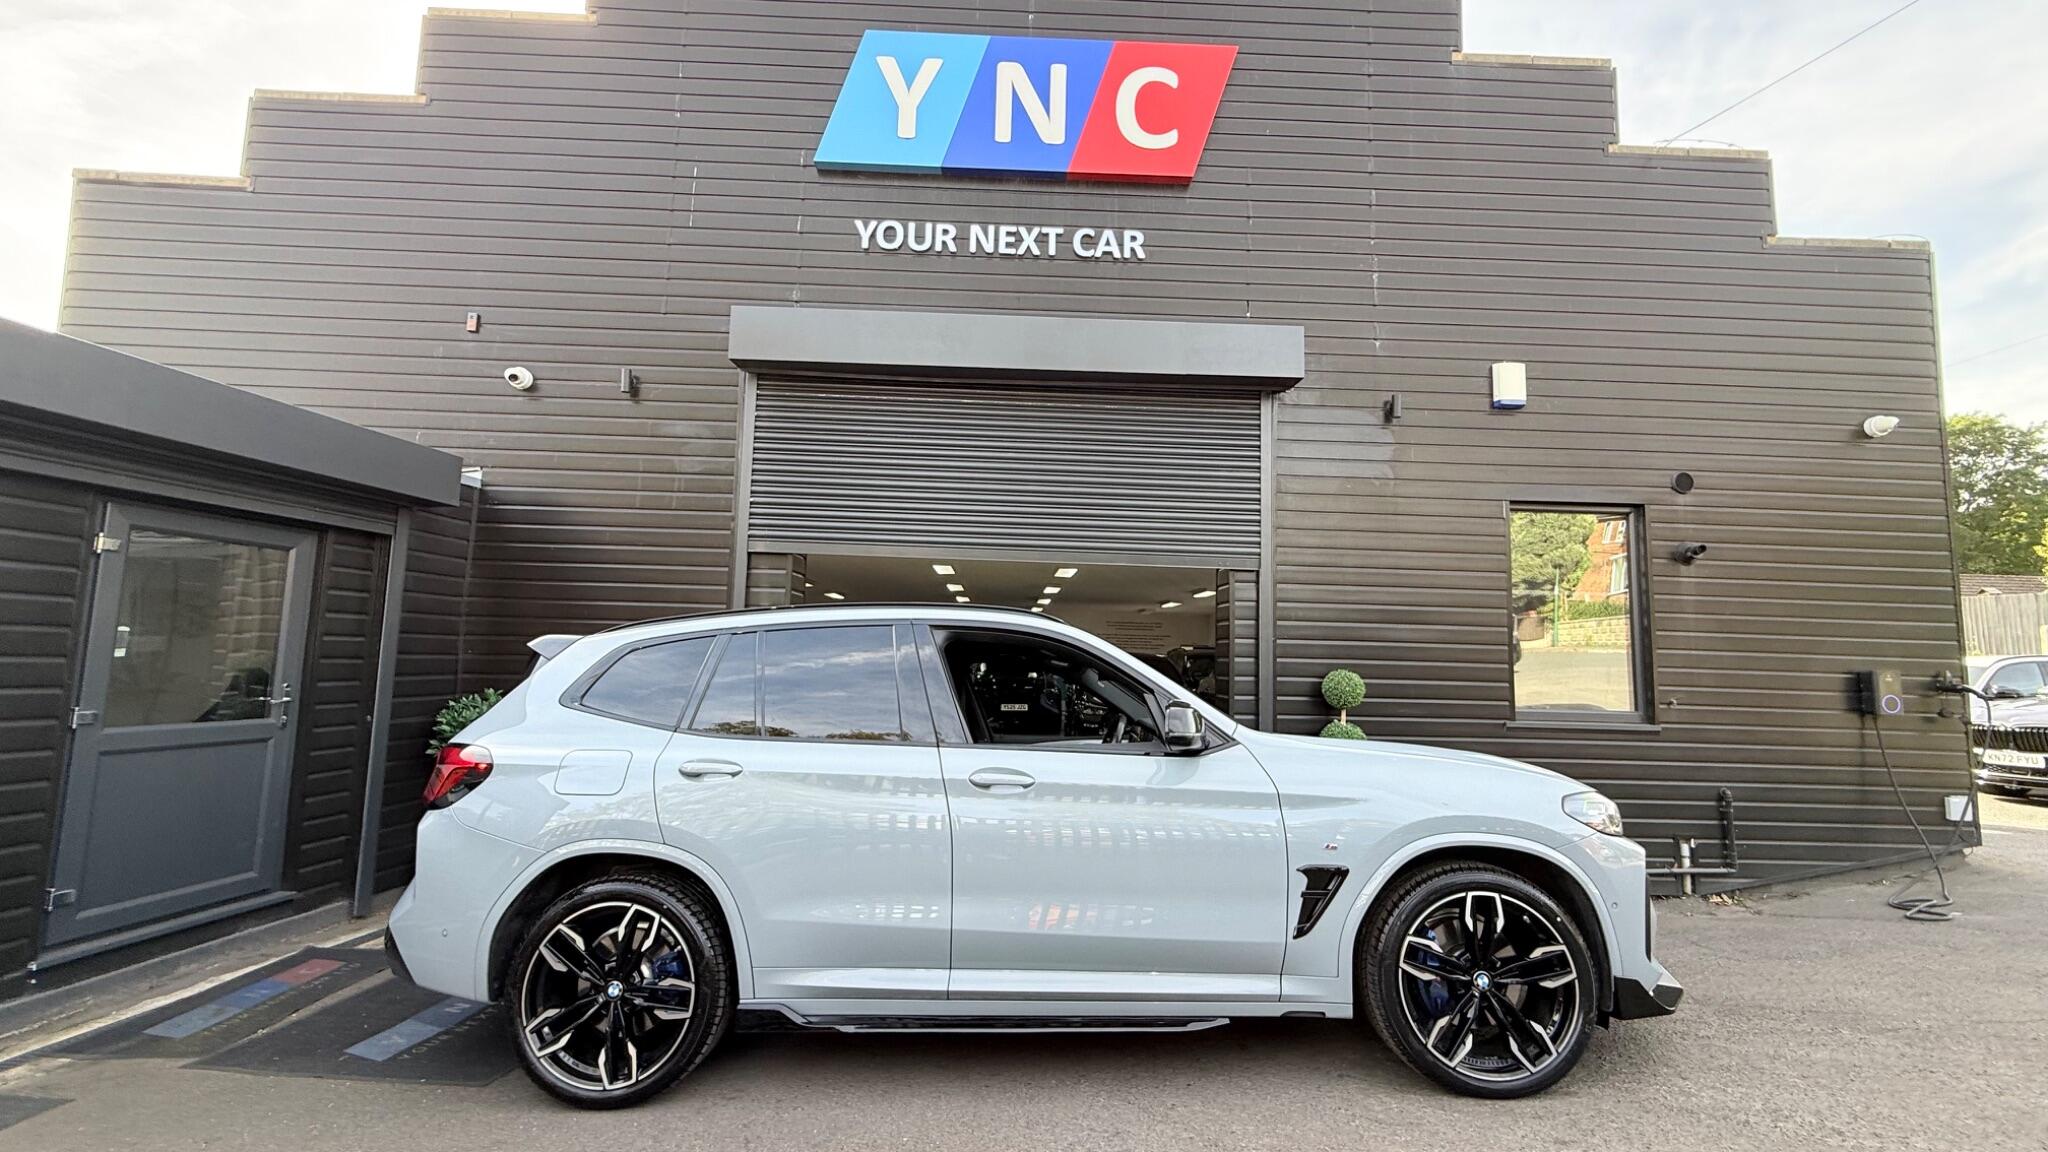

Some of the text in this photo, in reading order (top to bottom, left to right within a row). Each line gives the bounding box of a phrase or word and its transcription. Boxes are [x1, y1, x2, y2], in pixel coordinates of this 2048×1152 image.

[876, 56, 1180, 150] YNC
[854, 219, 1147, 260] YOUR NEXT CAR
